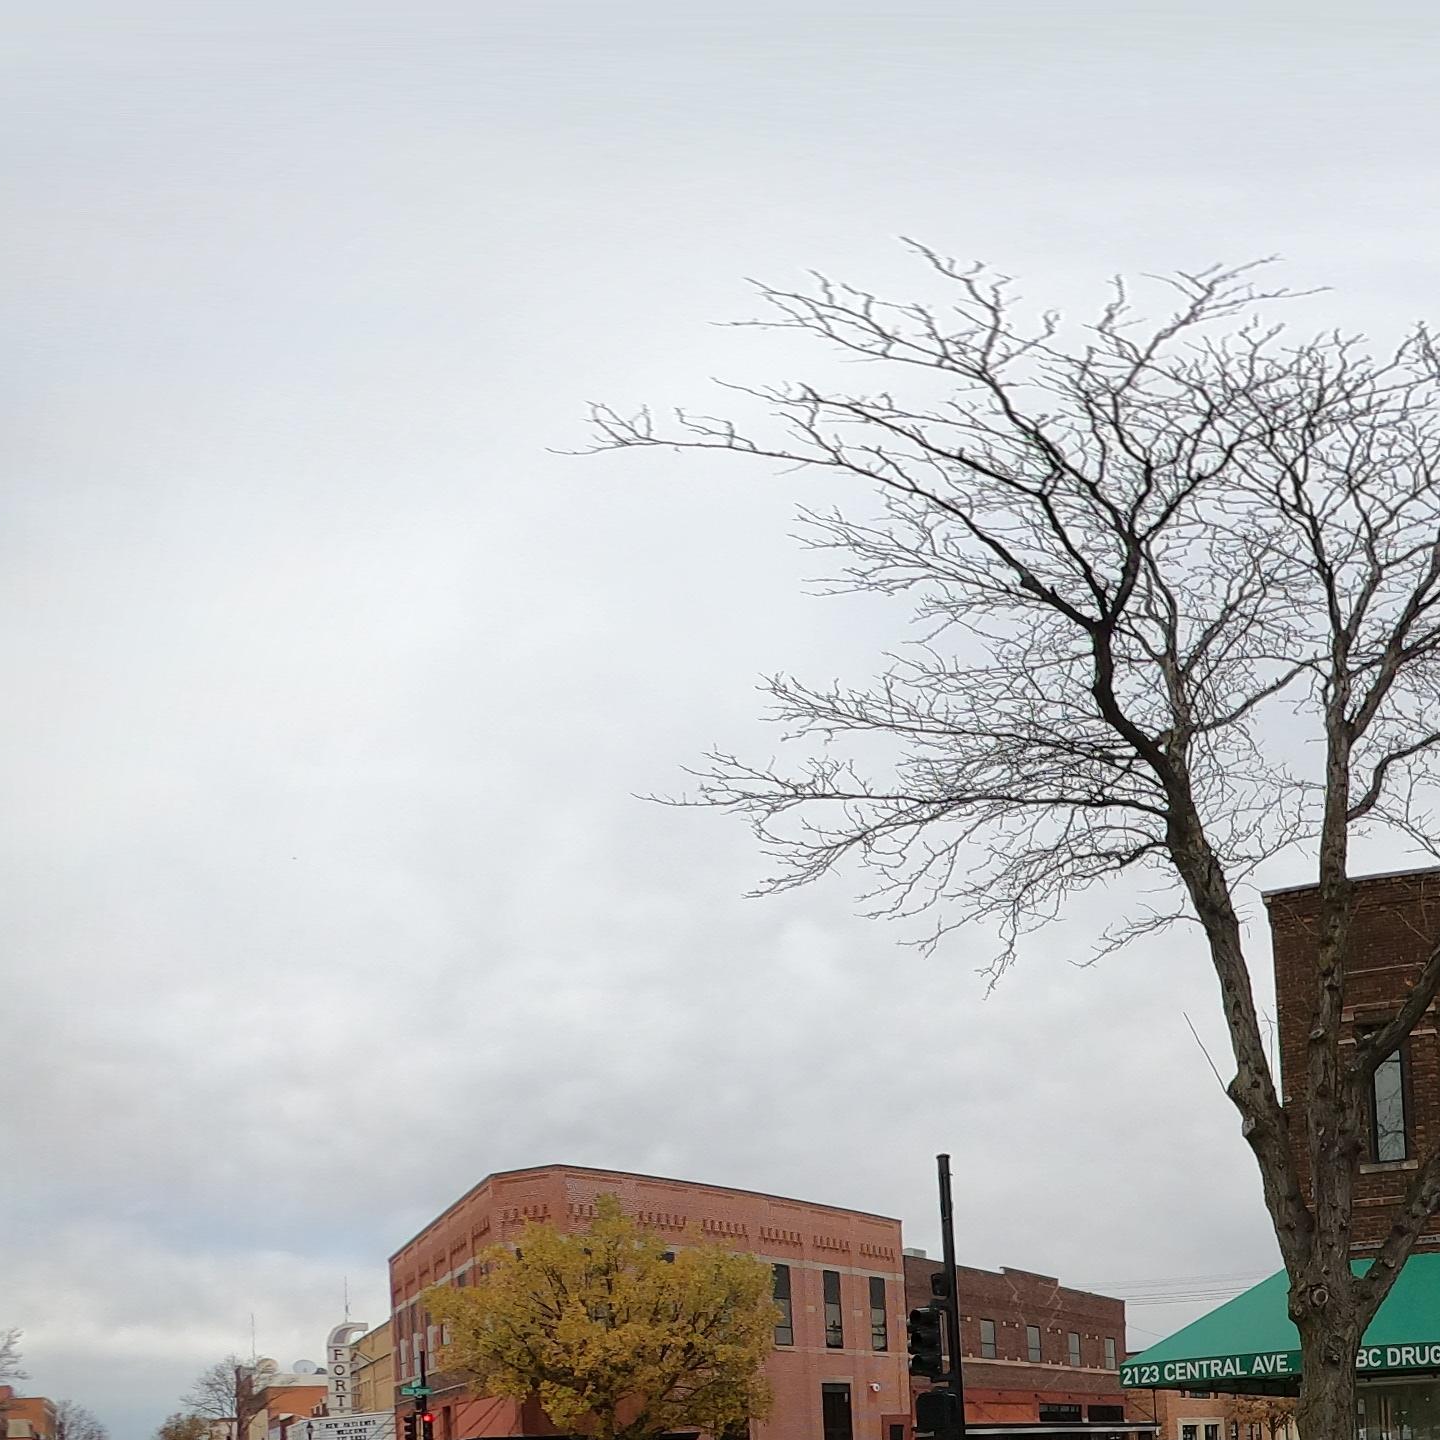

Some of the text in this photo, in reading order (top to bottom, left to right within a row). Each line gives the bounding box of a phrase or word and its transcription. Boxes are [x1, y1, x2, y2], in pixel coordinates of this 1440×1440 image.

[1122, 1354, 1293, 1385] 2123 CENTRAL AVE.
[1355, 1348, 1382, 1368] BC
[333, 1348, 347, 1407] FORT
[336, 1428, 367, 1436] WELCOME
